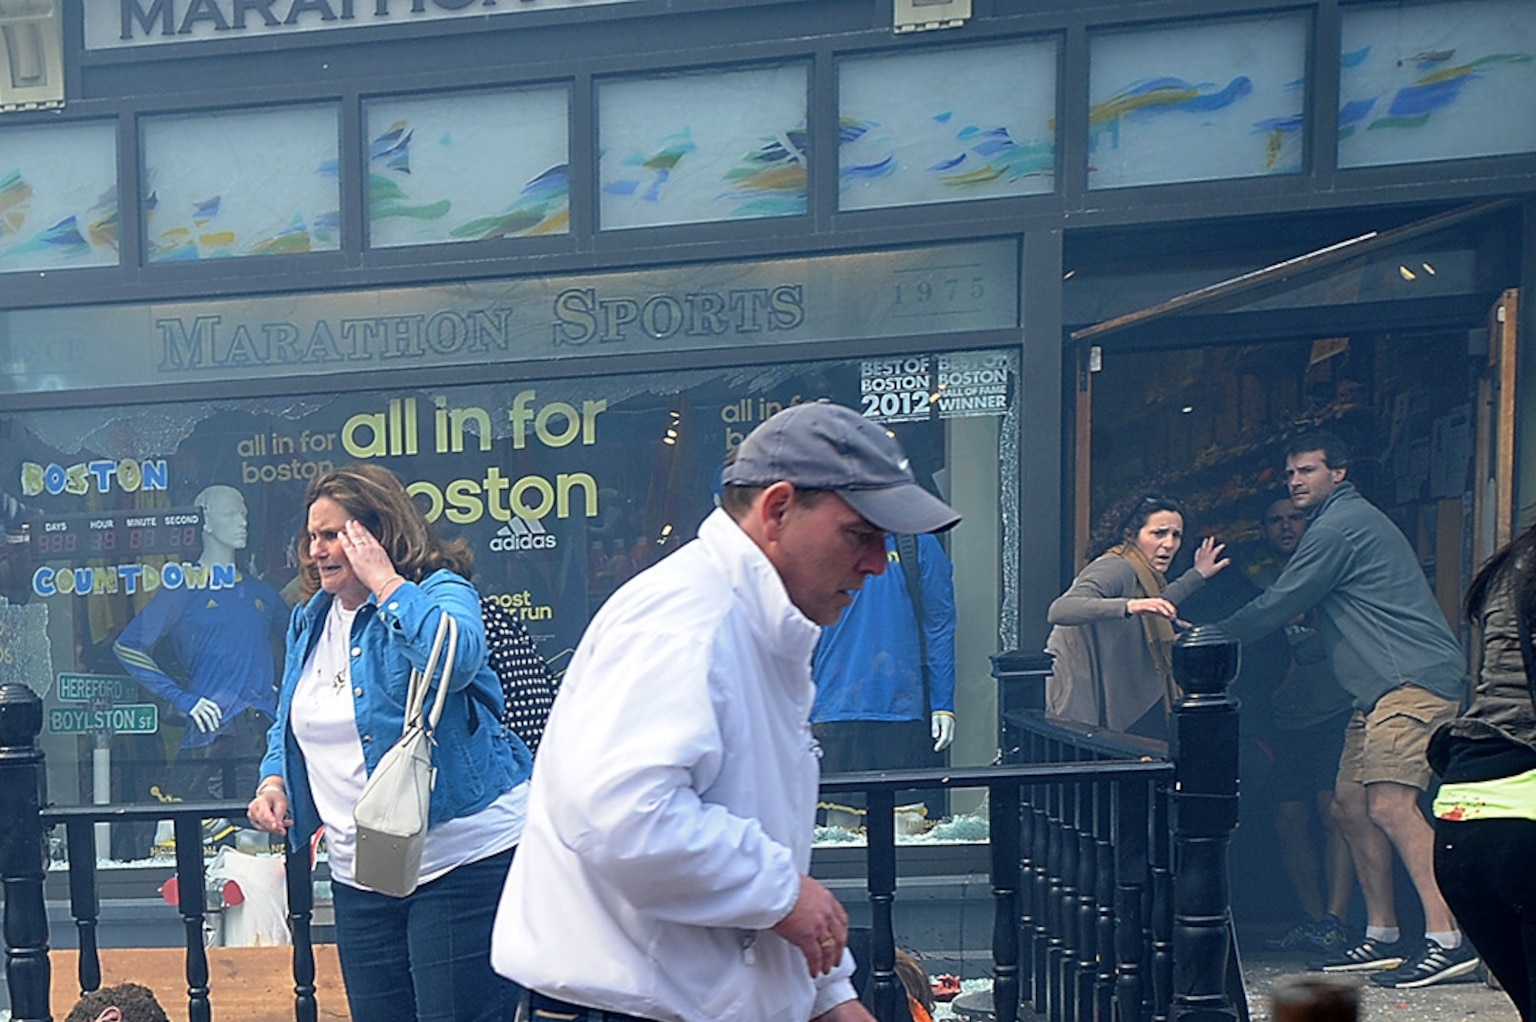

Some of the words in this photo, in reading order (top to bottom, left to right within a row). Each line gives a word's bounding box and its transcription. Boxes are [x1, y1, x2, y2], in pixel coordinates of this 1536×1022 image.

[892, 277, 985, 304] 1975
[156, 306, 513, 372] MARATHON
[553, 284, 805, 347] SPORTS
[861, 359, 903, 376] BEST
[904, 358, 930, 374] OF
[938, 369, 1007, 386] BOSTON
[861, 375, 930, 392] BOSTON
[965, 386, 978, 396] OF
[979, 385, 1006, 395] FAME
[721, 399, 752, 423] all
[861, 391, 930, 417] 2012
[938, 395, 1006, 411] WINNER
[341, 397, 417, 459] all
[435, 395, 491, 452] in
[509, 389, 608, 449] for
[237, 434, 266, 457] all
[272, 433, 294, 455] in
[300, 430, 336, 452] for
[21, 458, 168, 495] BOSTON
[242, 459, 333, 483] boston
[405, 467, 598, 523] oston
[45, 522, 67, 532] DAYS
[90, 519, 114, 529] HOUR
[126, 517, 157, 527] MINUTE
[164, 515, 199, 525] SECOND
[489, 533, 557, 551] adidas
[32, 562, 236, 597] COUNTDOWN
[520, 605, 552, 620] run
[61, 678, 121, 698] HEREFORD
[51, 709, 135, 730] BOYLSTON
[139, 716, 152, 729] ST
